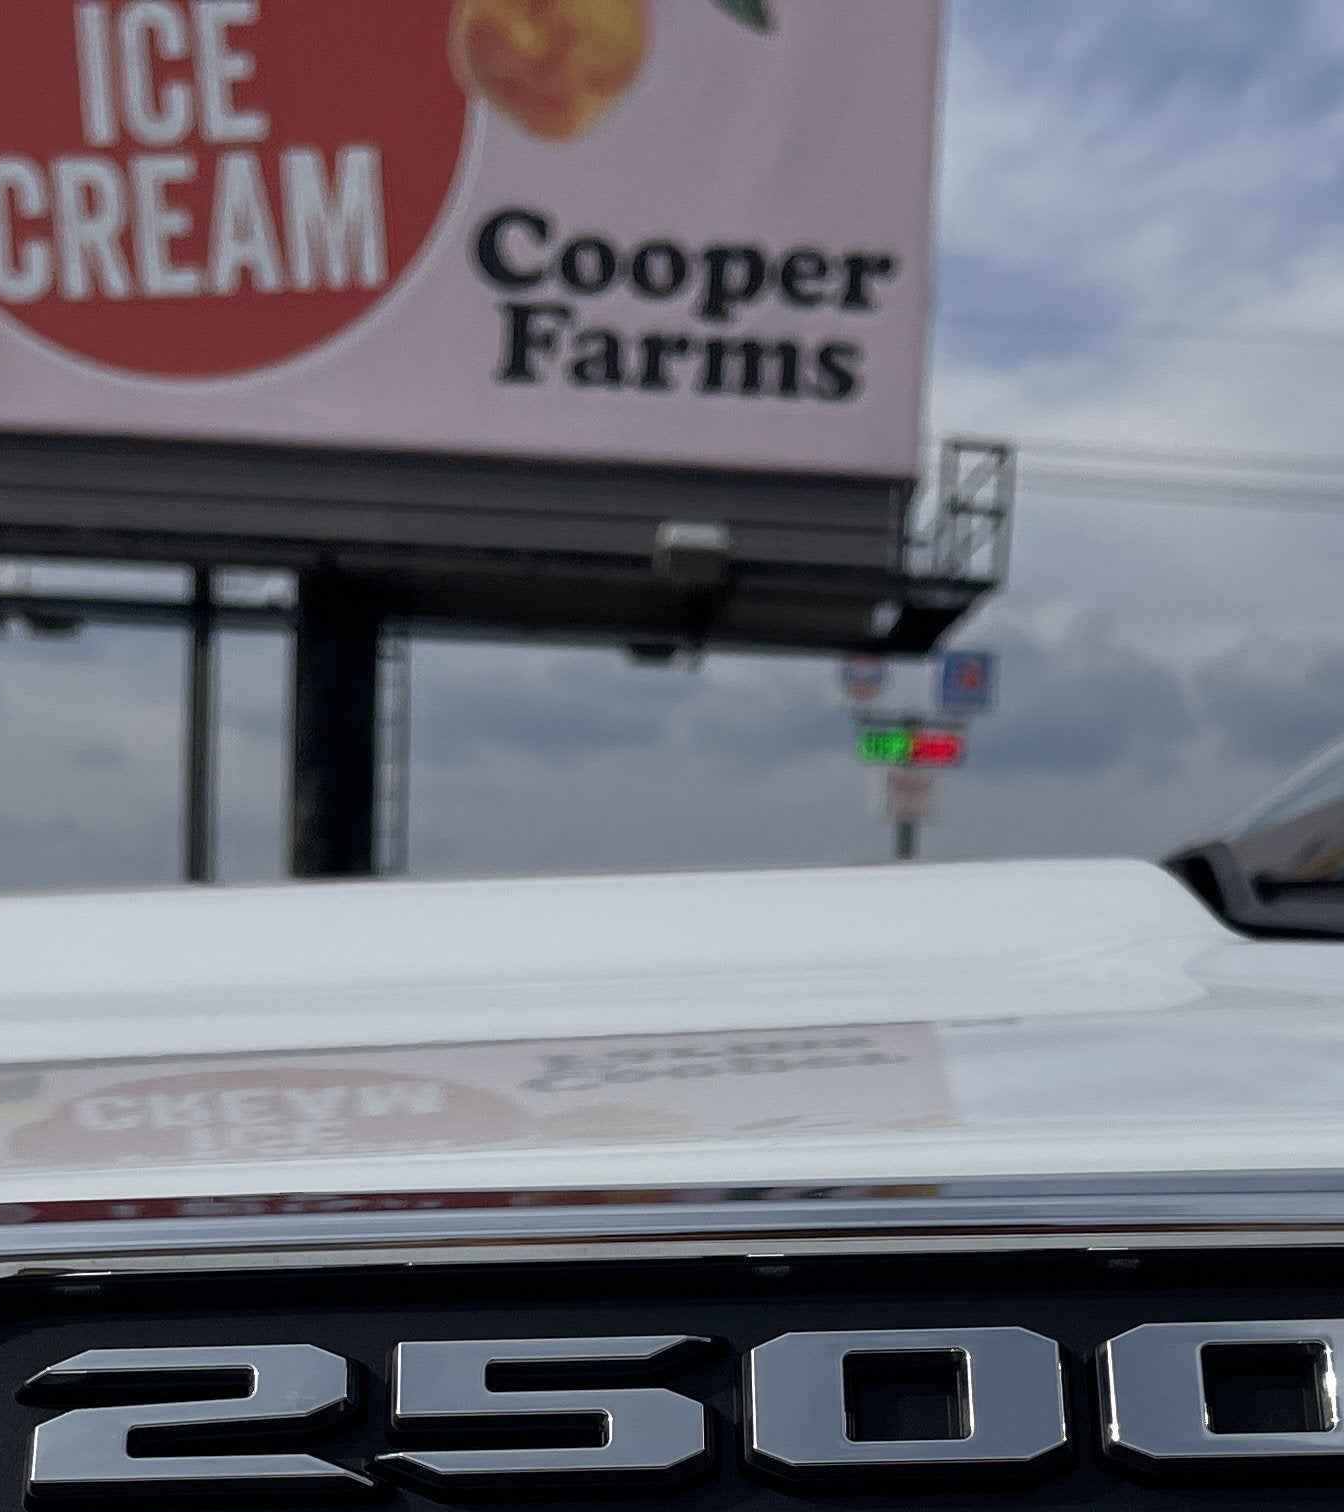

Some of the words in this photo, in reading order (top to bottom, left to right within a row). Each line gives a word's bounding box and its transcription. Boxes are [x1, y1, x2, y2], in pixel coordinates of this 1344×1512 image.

[74, 0, 271, 146] ICE
[472, 206, 896, 321] Cooper
[495, 300, 862, 398] Farms
